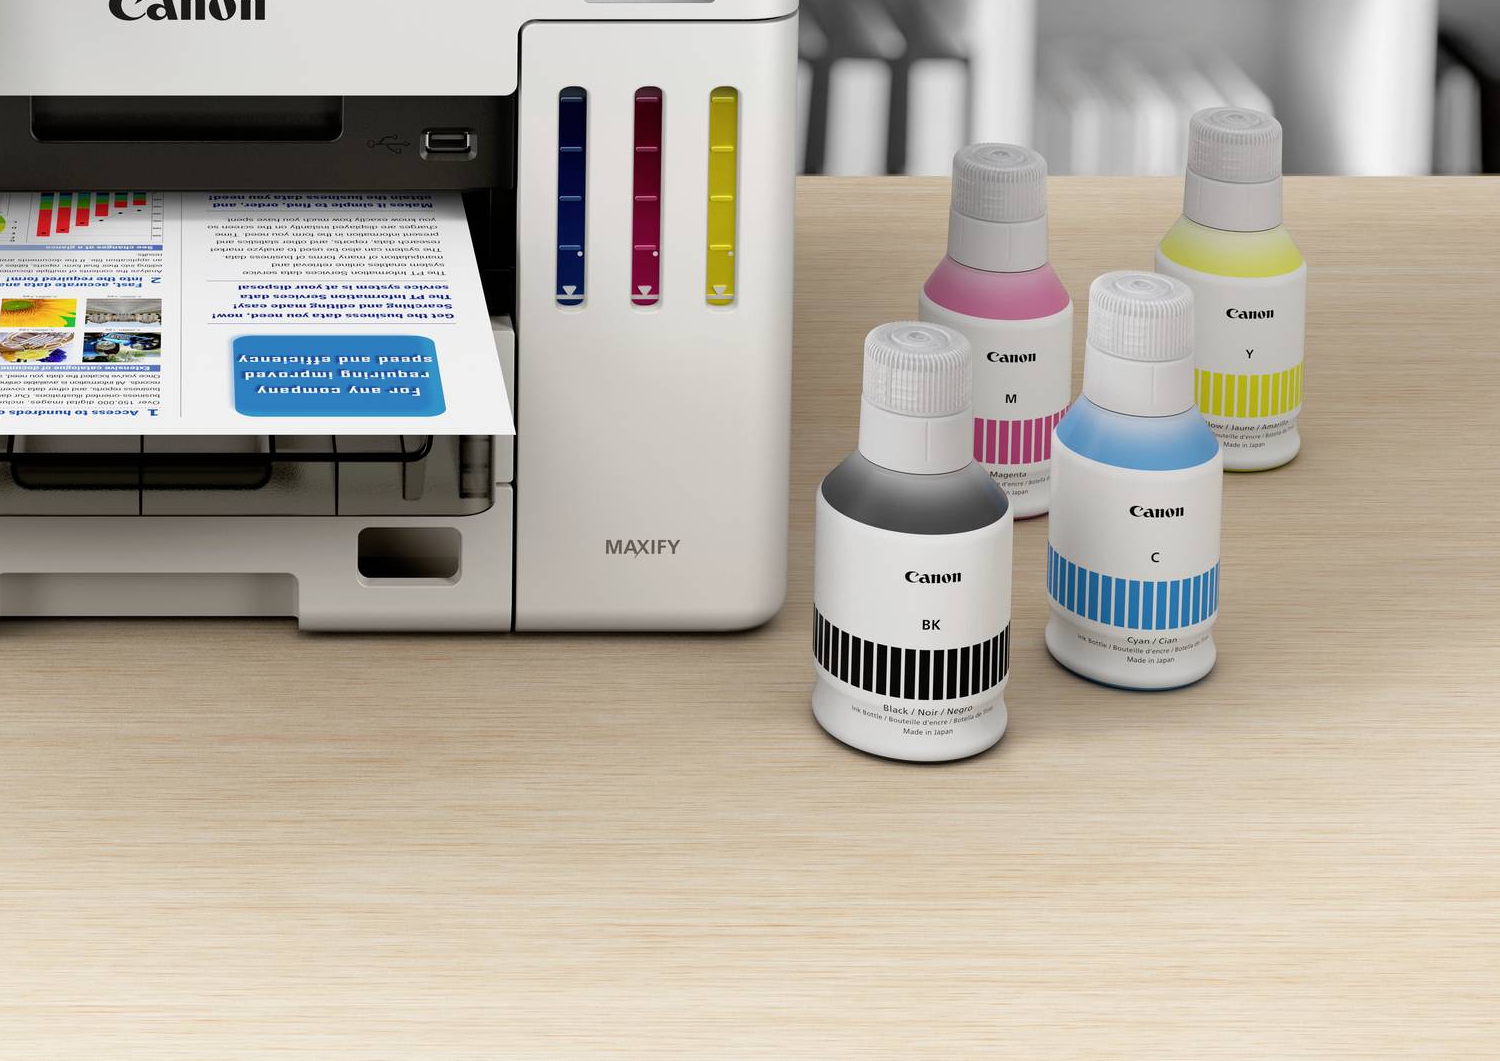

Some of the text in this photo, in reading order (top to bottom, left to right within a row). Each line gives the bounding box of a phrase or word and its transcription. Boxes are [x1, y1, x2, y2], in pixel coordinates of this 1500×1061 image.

[150, 276, 162, 284] 2
[233, 302, 267, 310] easy!
[309, 302, 356, 310] editing
[386, 302, 453, 310] Searching
[1226, 309, 1274, 319] Canon
[987, 352, 1036, 363] Canon
[1246, 349, 1254, 358] Y
[239, 354, 433, 366] speed and efficiency
[245, 369, 430, 381] requiring improved
[257, 385, 421, 397] For any company
[1005, 394, 1017, 404] M
[91, 409, 139, 417] Access
[147, 408, 159, 417] 1
[1249, 441, 1265, 449] Japan
[1130, 506, 1184, 518] Canon
[606, 539, 680, 558] MAXIFY
[1151, 552, 1160, 562] C
[905, 571, 961, 583] Canon
[922, 619, 941, 630] BK
[1088, 637, 1107, 648] Bottle
[1113, 644, 1144, 654] Bouteille
[1127, 637, 1150, 645] Cyan
[883, 704, 908, 715] Black
[947, 704, 973, 716] Negro
[862, 709, 882, 720] Bottle
[889, 717, 920, 726] Bouteille
[923, 718, 947, 726] d'encre
[954, 713, 974, 724] Botella
[934, 727, 953, 736] Japan
